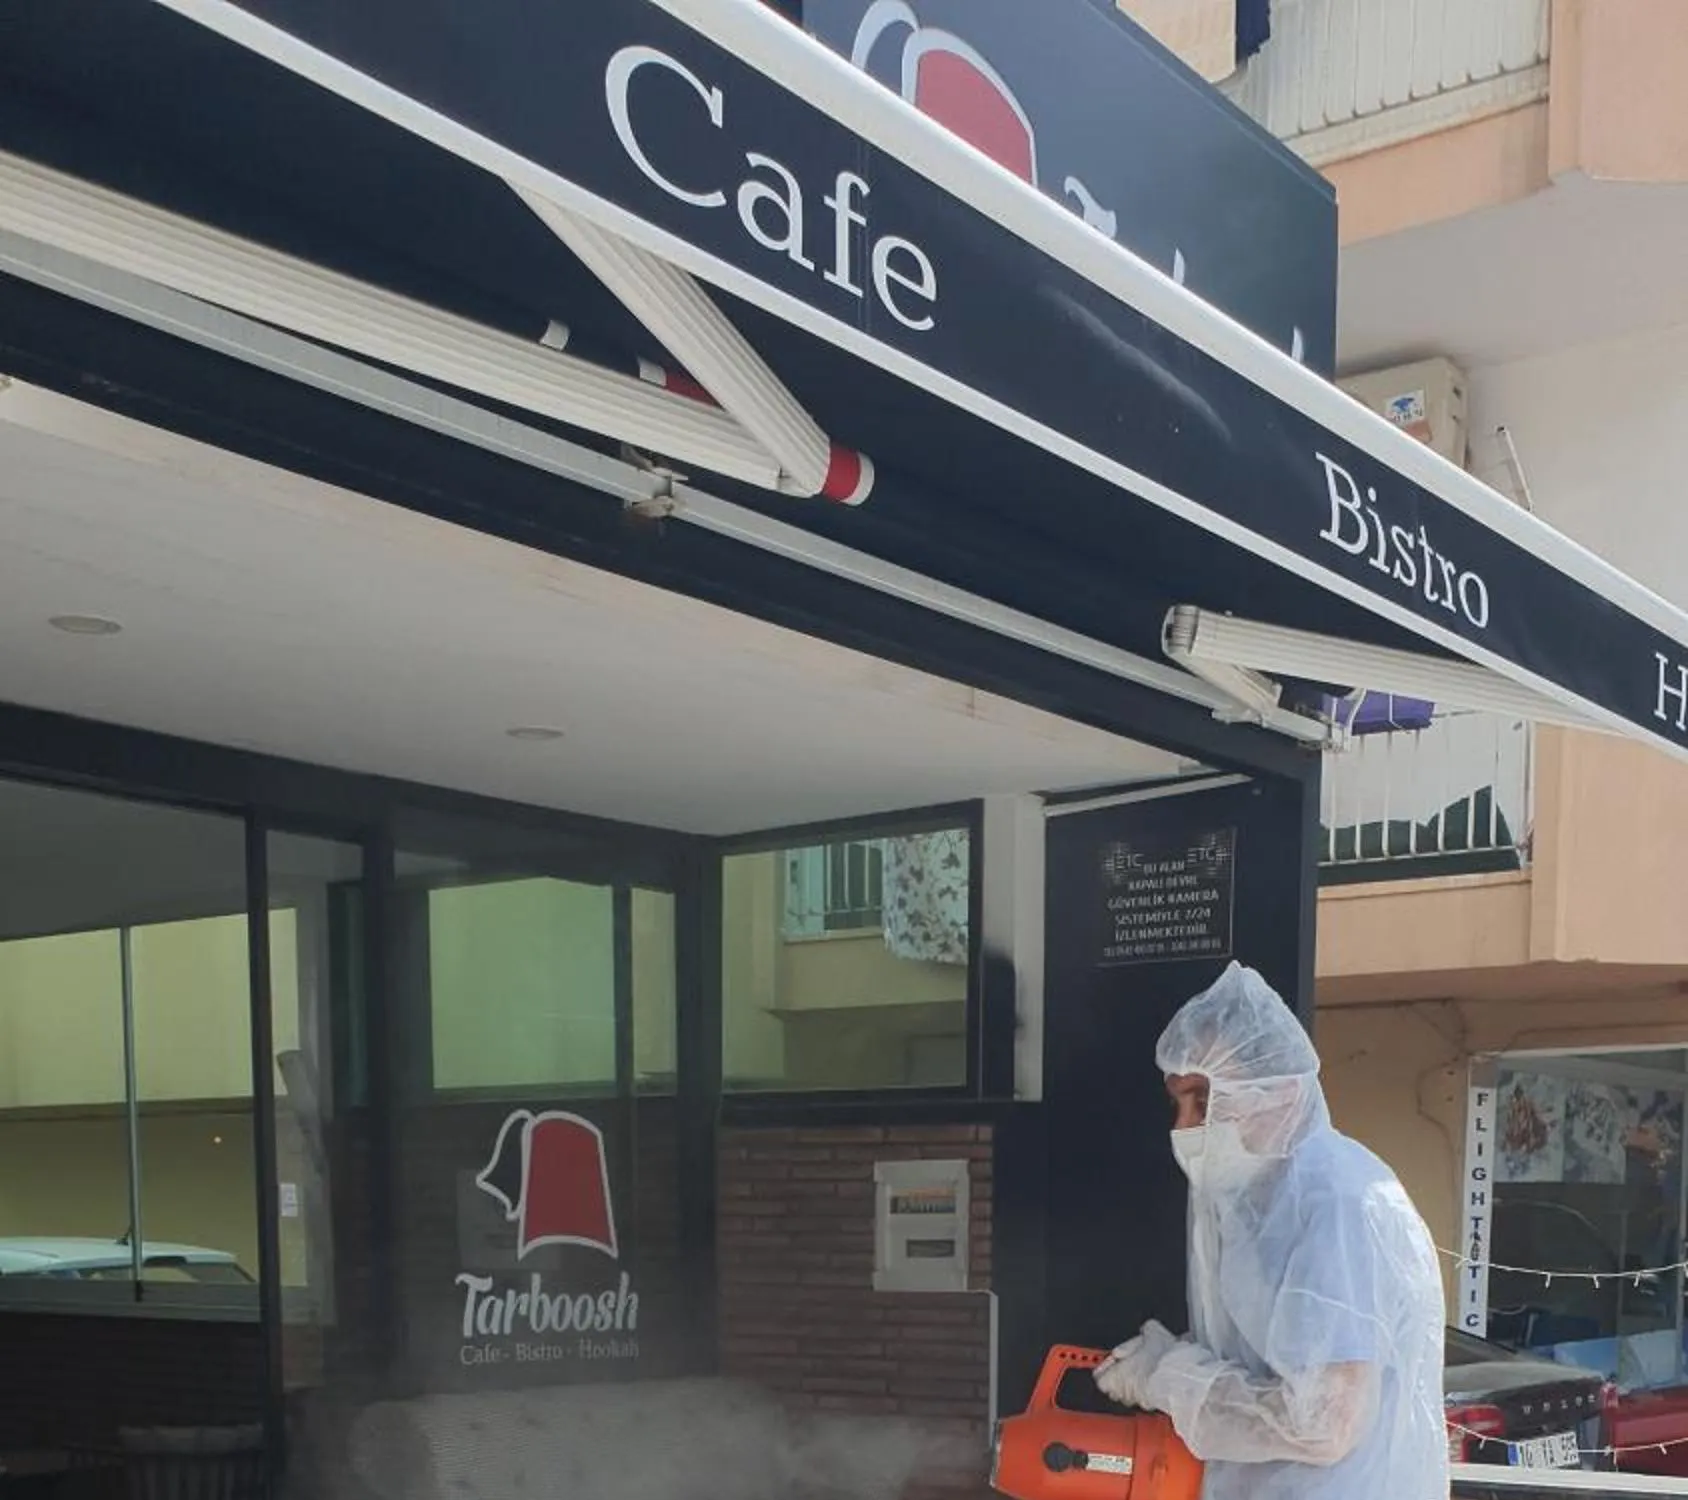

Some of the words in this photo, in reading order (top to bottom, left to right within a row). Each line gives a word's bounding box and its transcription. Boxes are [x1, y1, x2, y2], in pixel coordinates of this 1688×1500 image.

[605, 45, 938, 331] Cafe
[1315, 452, 1490, 629] Bistro
[455, 1271, 639, 1338] Tarboosh
[460, 1342, 501, 1366] Cafe
[515, 1342, 563, 1362] Bistro
[579, 1338, 640, 1362] Hookah
